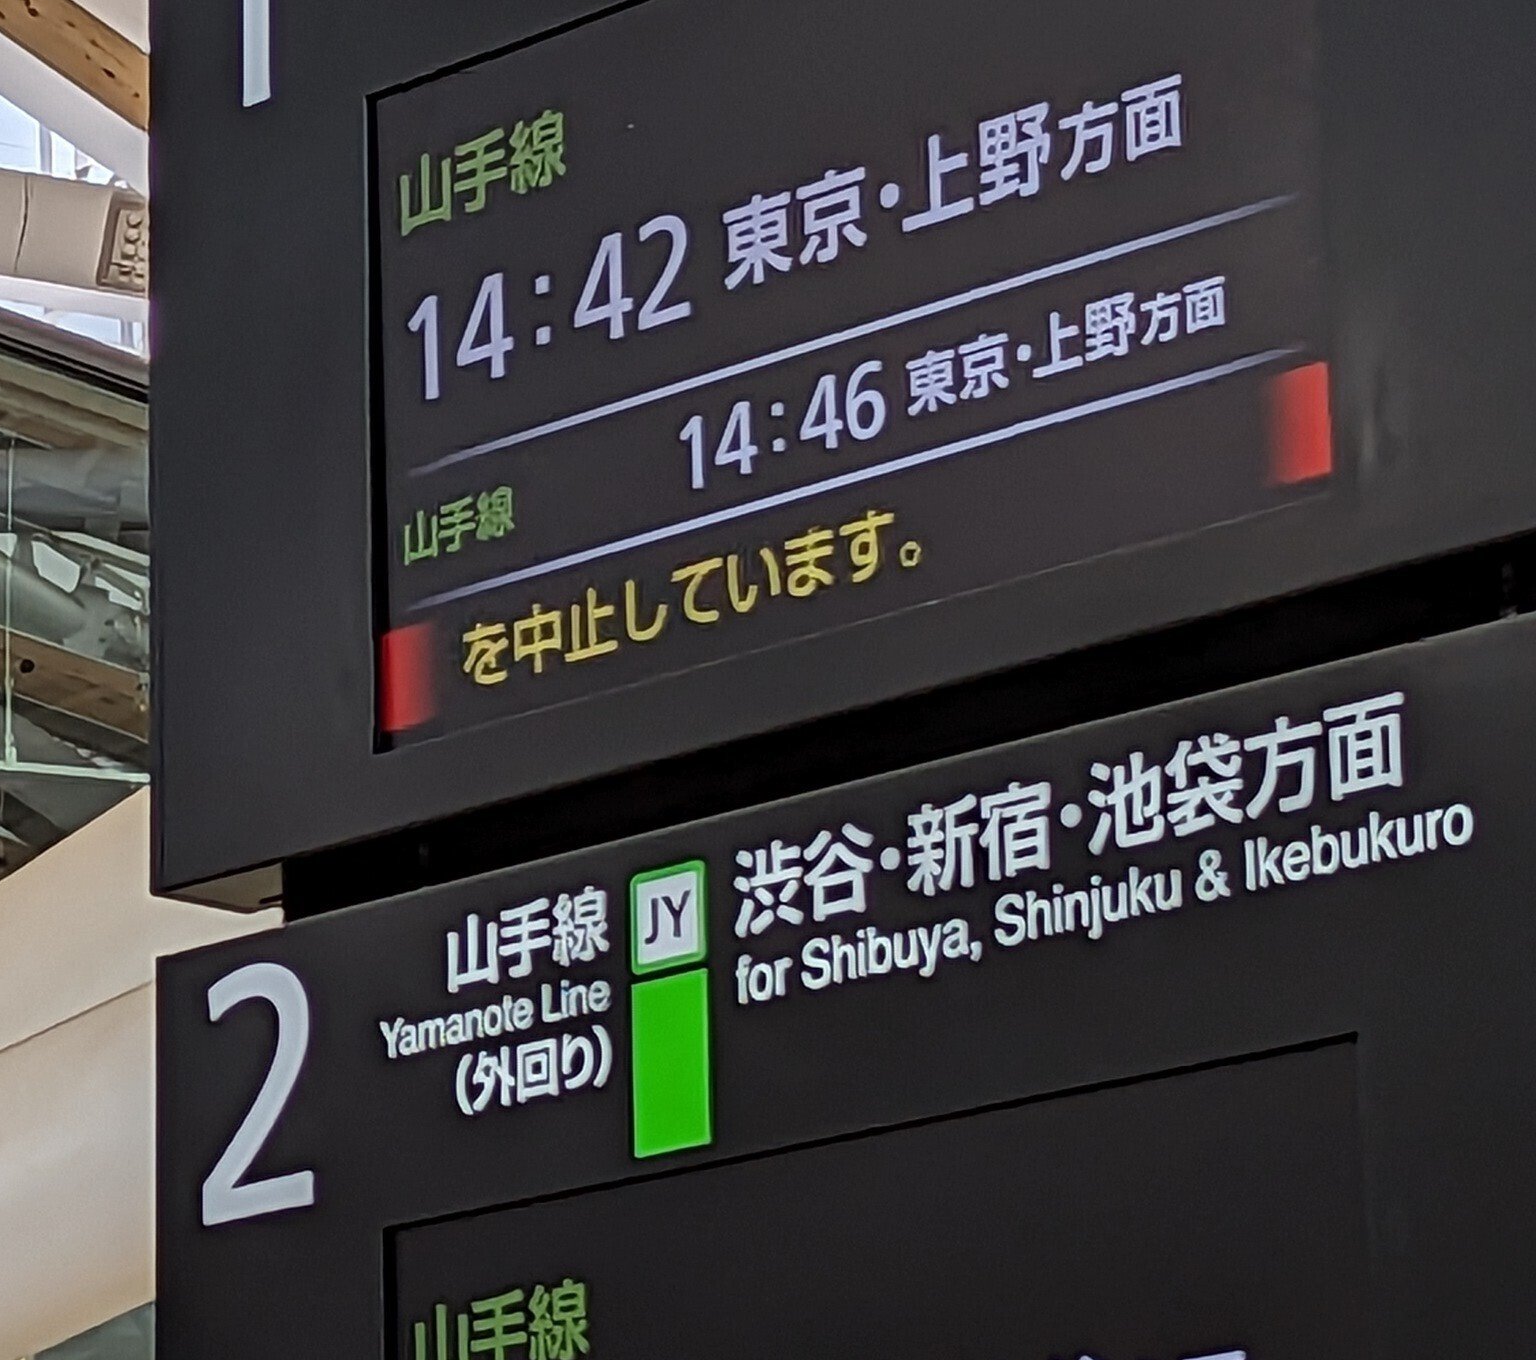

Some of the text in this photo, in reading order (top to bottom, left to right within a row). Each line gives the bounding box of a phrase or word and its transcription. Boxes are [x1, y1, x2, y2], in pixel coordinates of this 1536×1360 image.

[399, 109, 568, 236] 山手線
[407, 74, 1184, 400] 14:42 東京・上野方面
[403, 277, 1227, 566] 山手線 14:46 東京・上野方面
[462, 510, 922, 686] を中止しています。
[733, 691, 1405, 937] 渋谷・新宿・池袋方面
[447, 885, 610, 994] 山手線
[644, 890, 691, 946] JY
[735, 802, 1474, 1005] for Shibuya, Shinjuku & Ikebukuro
[203, 962, 314, 1226] 2
[380, 980, 612, 1059] Yamanote Line
[456, 1025, 613, 1116] (外回り)
